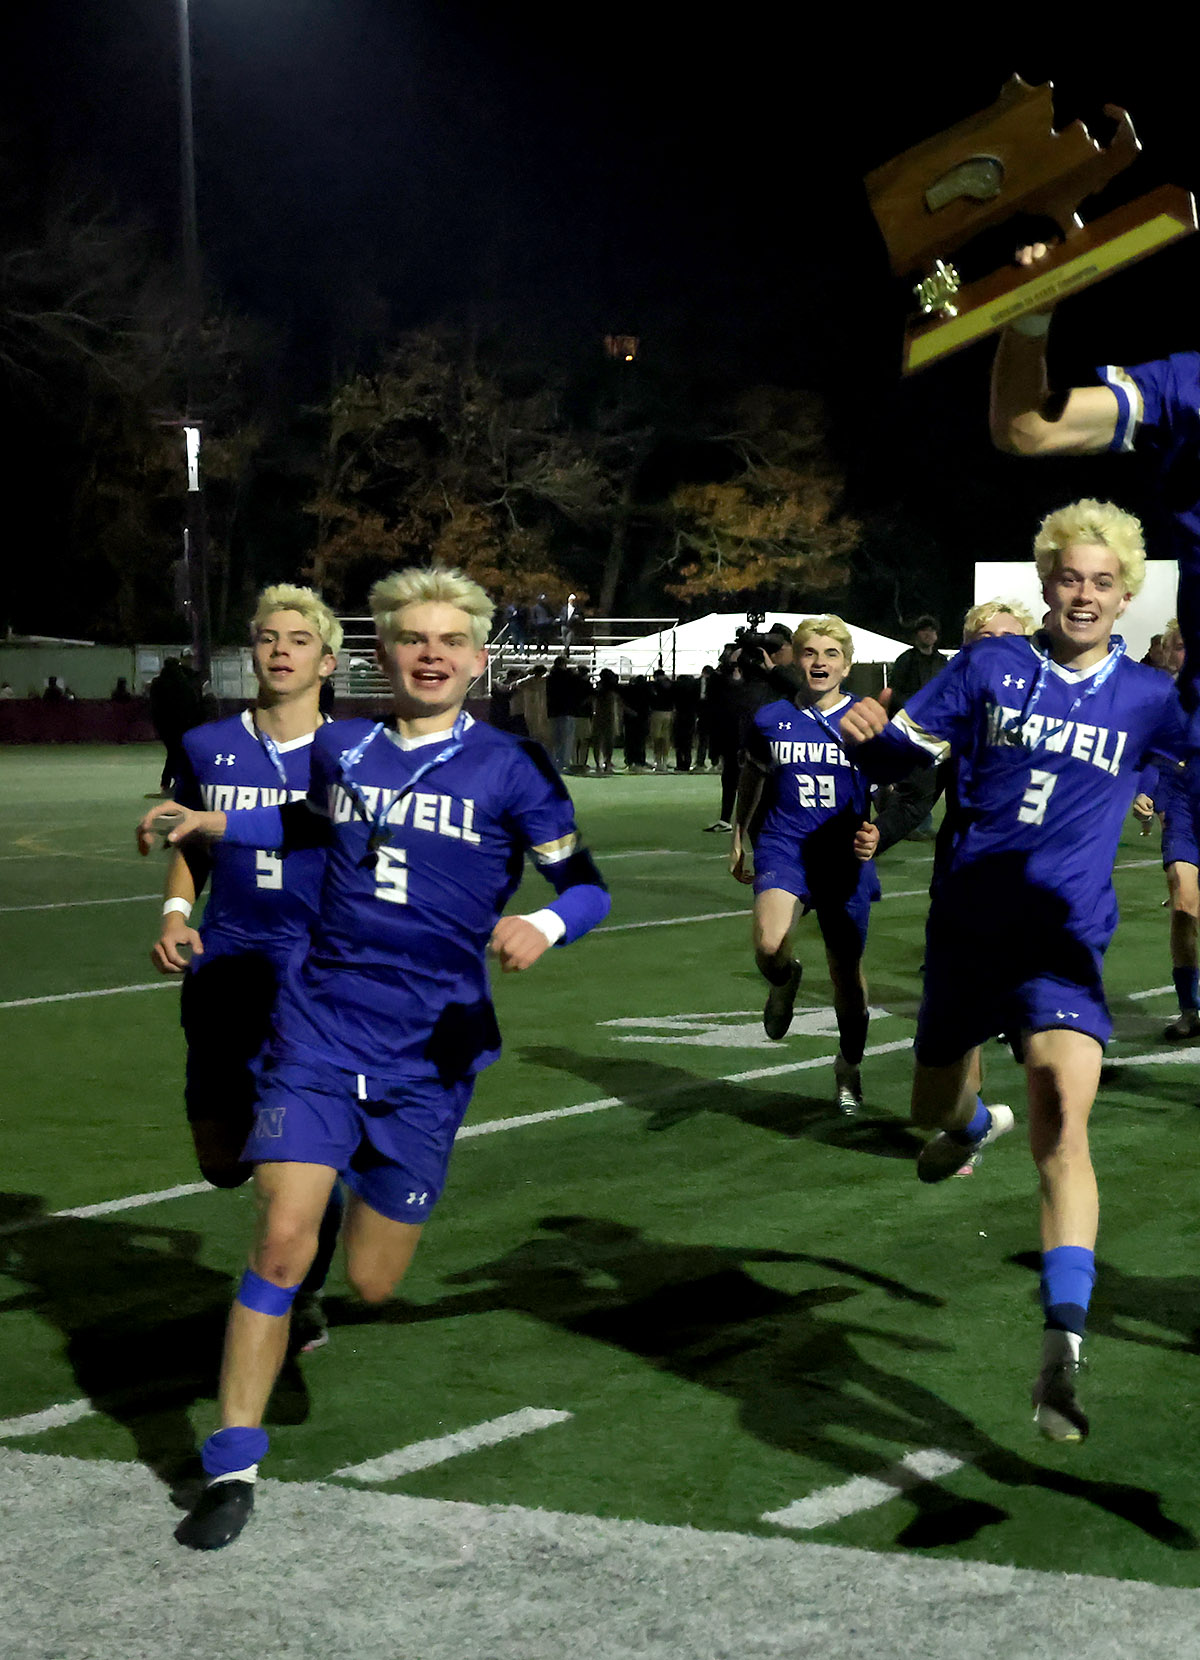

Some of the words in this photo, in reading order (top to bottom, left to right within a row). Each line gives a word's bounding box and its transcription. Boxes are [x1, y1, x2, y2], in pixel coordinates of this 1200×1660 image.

[769, 741, 859, 771] NORWEL
[795, 774, 837, 809] 29
[1017, 768, 1059, 826] 3
[374, 845, 408, 905] 5
